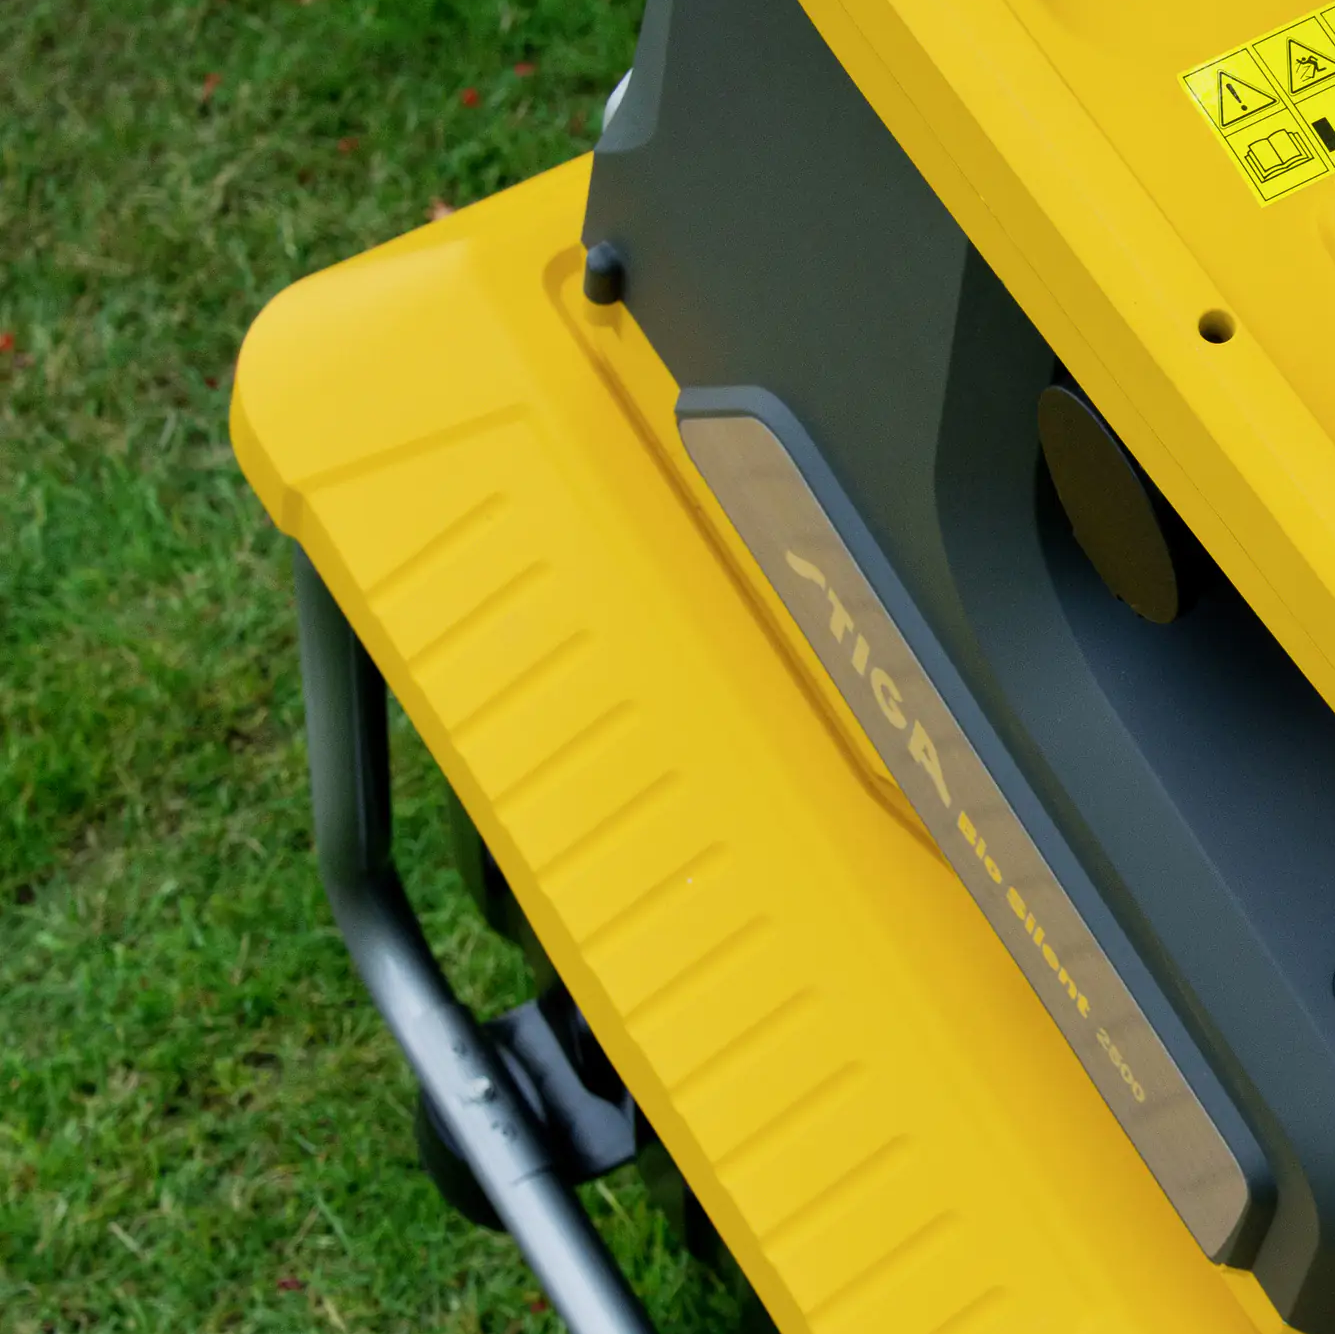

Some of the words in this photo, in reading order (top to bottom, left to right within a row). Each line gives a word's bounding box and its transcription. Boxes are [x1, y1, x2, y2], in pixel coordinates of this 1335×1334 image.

[785, 550, 952, 808] STIGA
[957, 810, 1003, 884] Bio
[1006, 887, 1092, 1018] Silent
